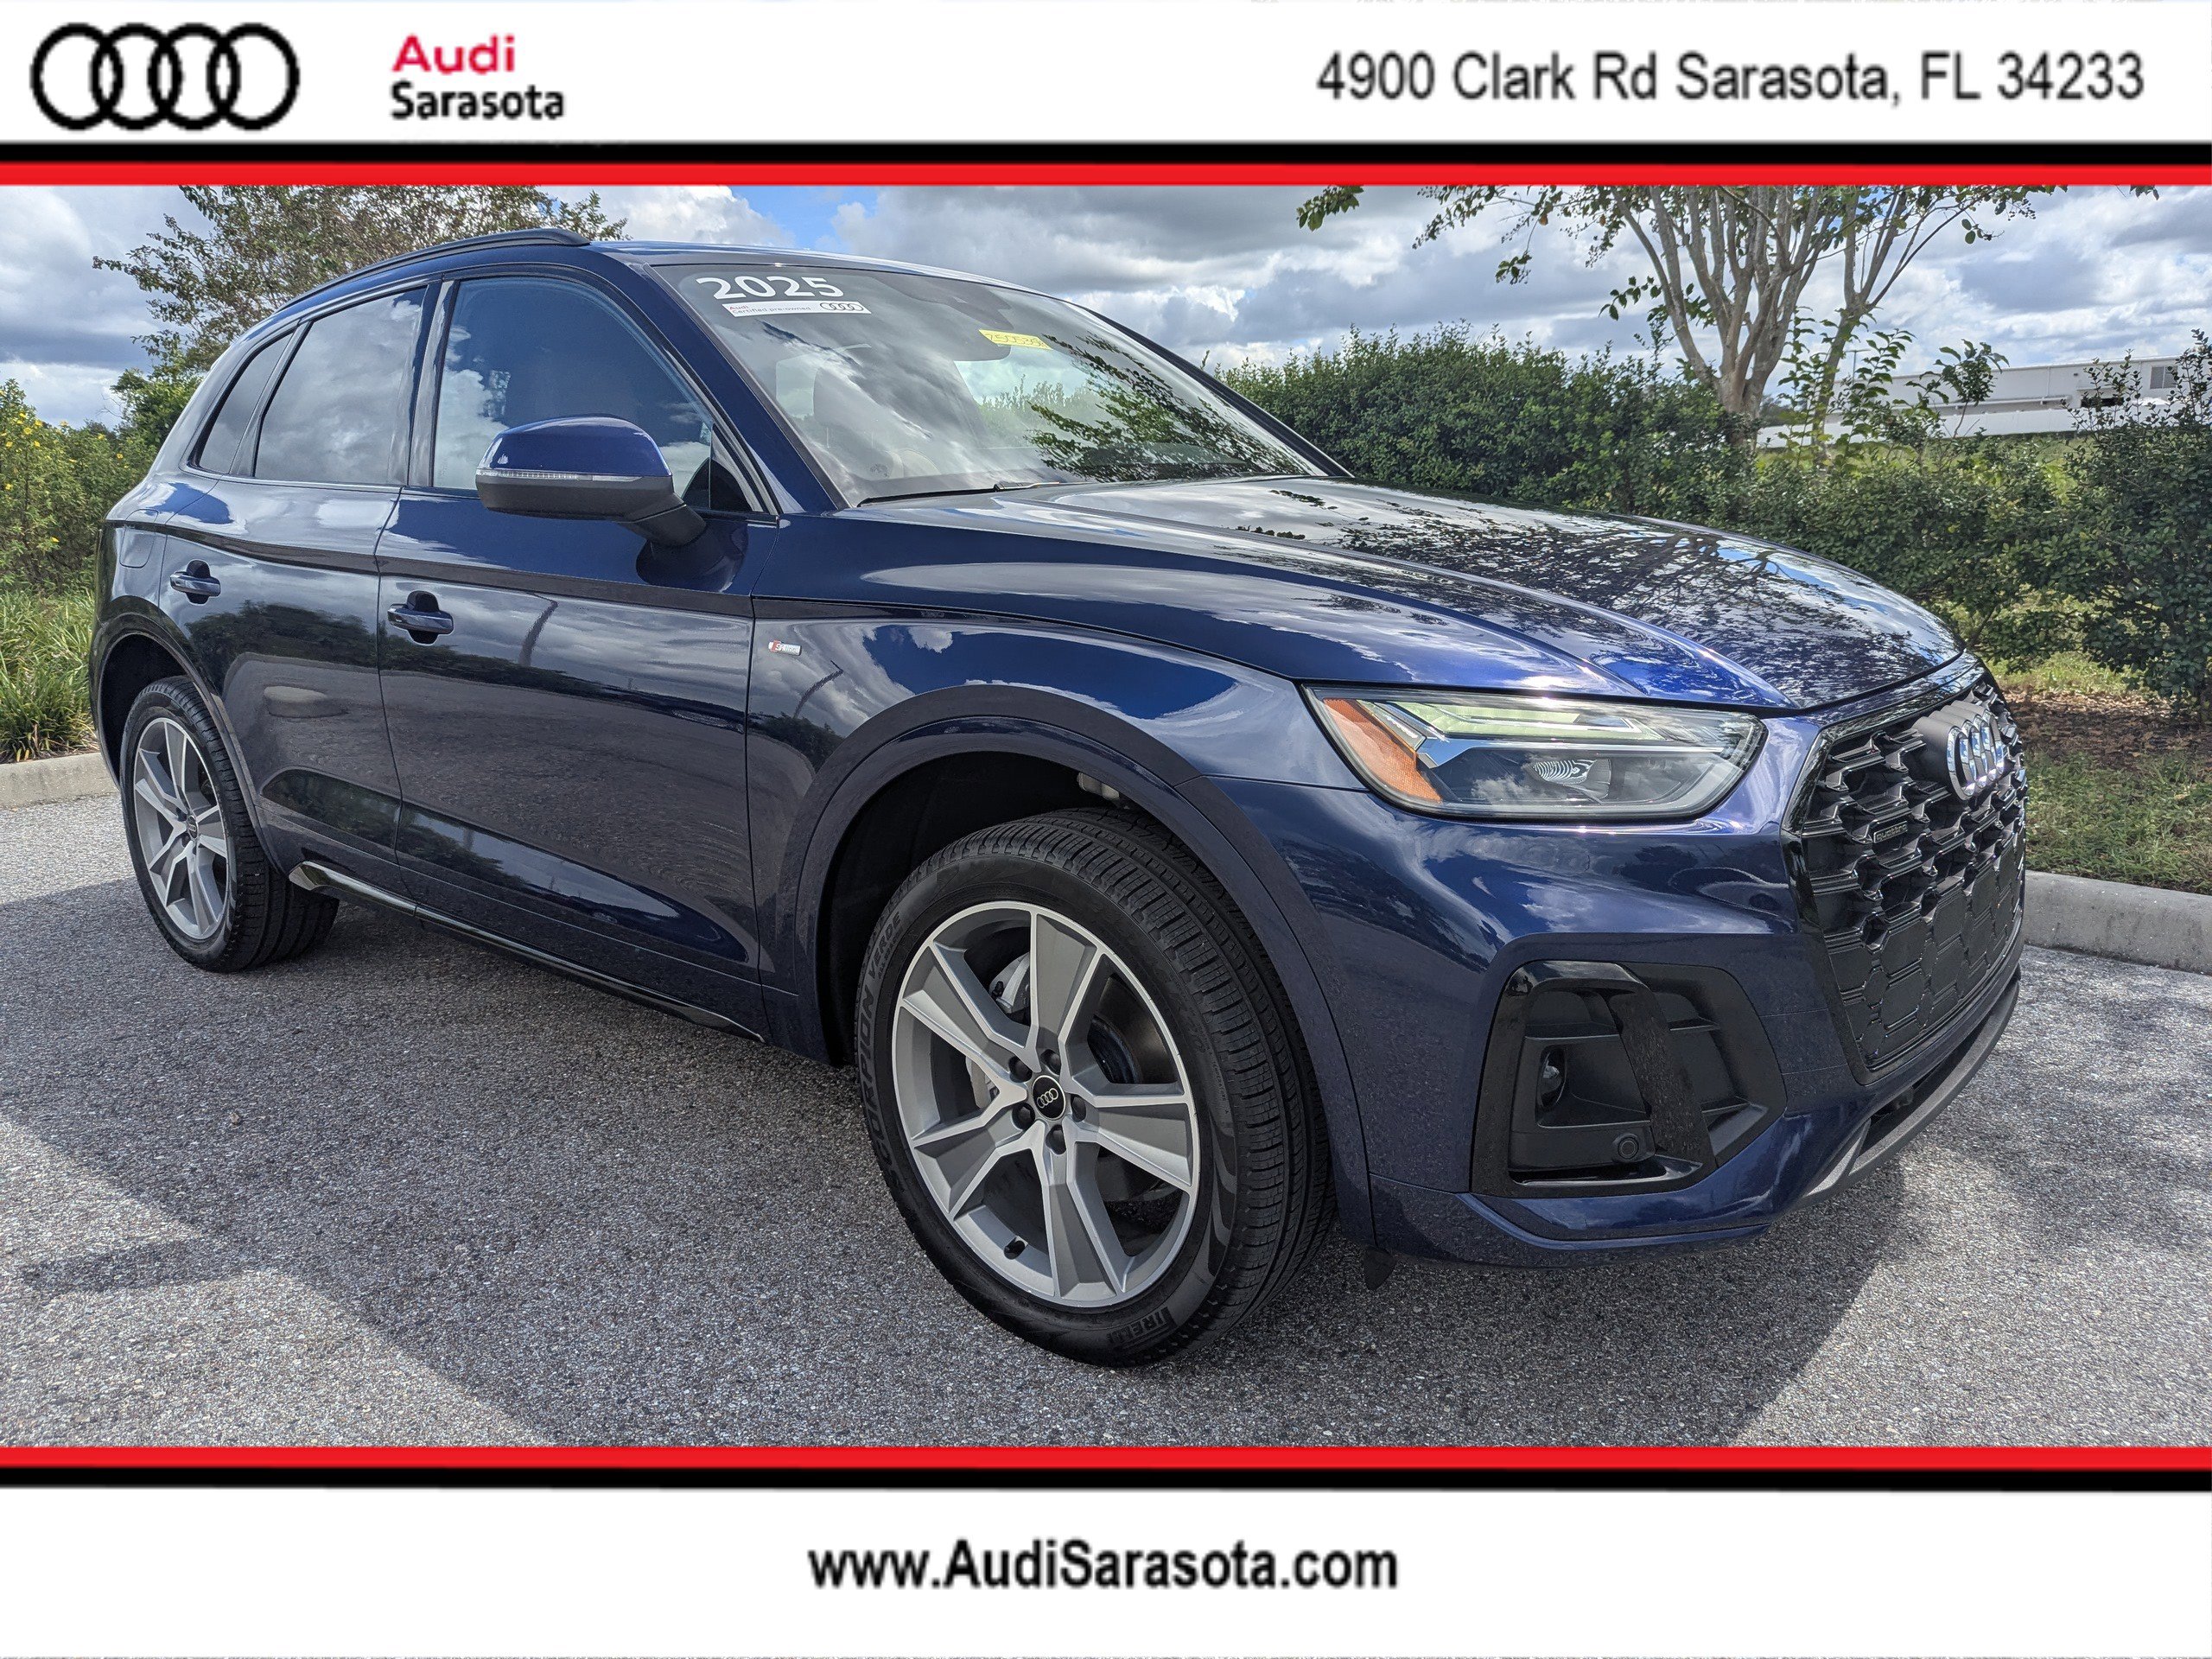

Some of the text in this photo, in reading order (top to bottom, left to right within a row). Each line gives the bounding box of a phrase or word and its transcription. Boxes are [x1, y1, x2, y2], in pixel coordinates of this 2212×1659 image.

[696, 276, 844, 300] 2025
[1876, 823, 1908, 841] quattro
[859, 911, 905, 1195] SCORPION VERDE
[1107, 1306, 1178, 1345] PIRELLI
